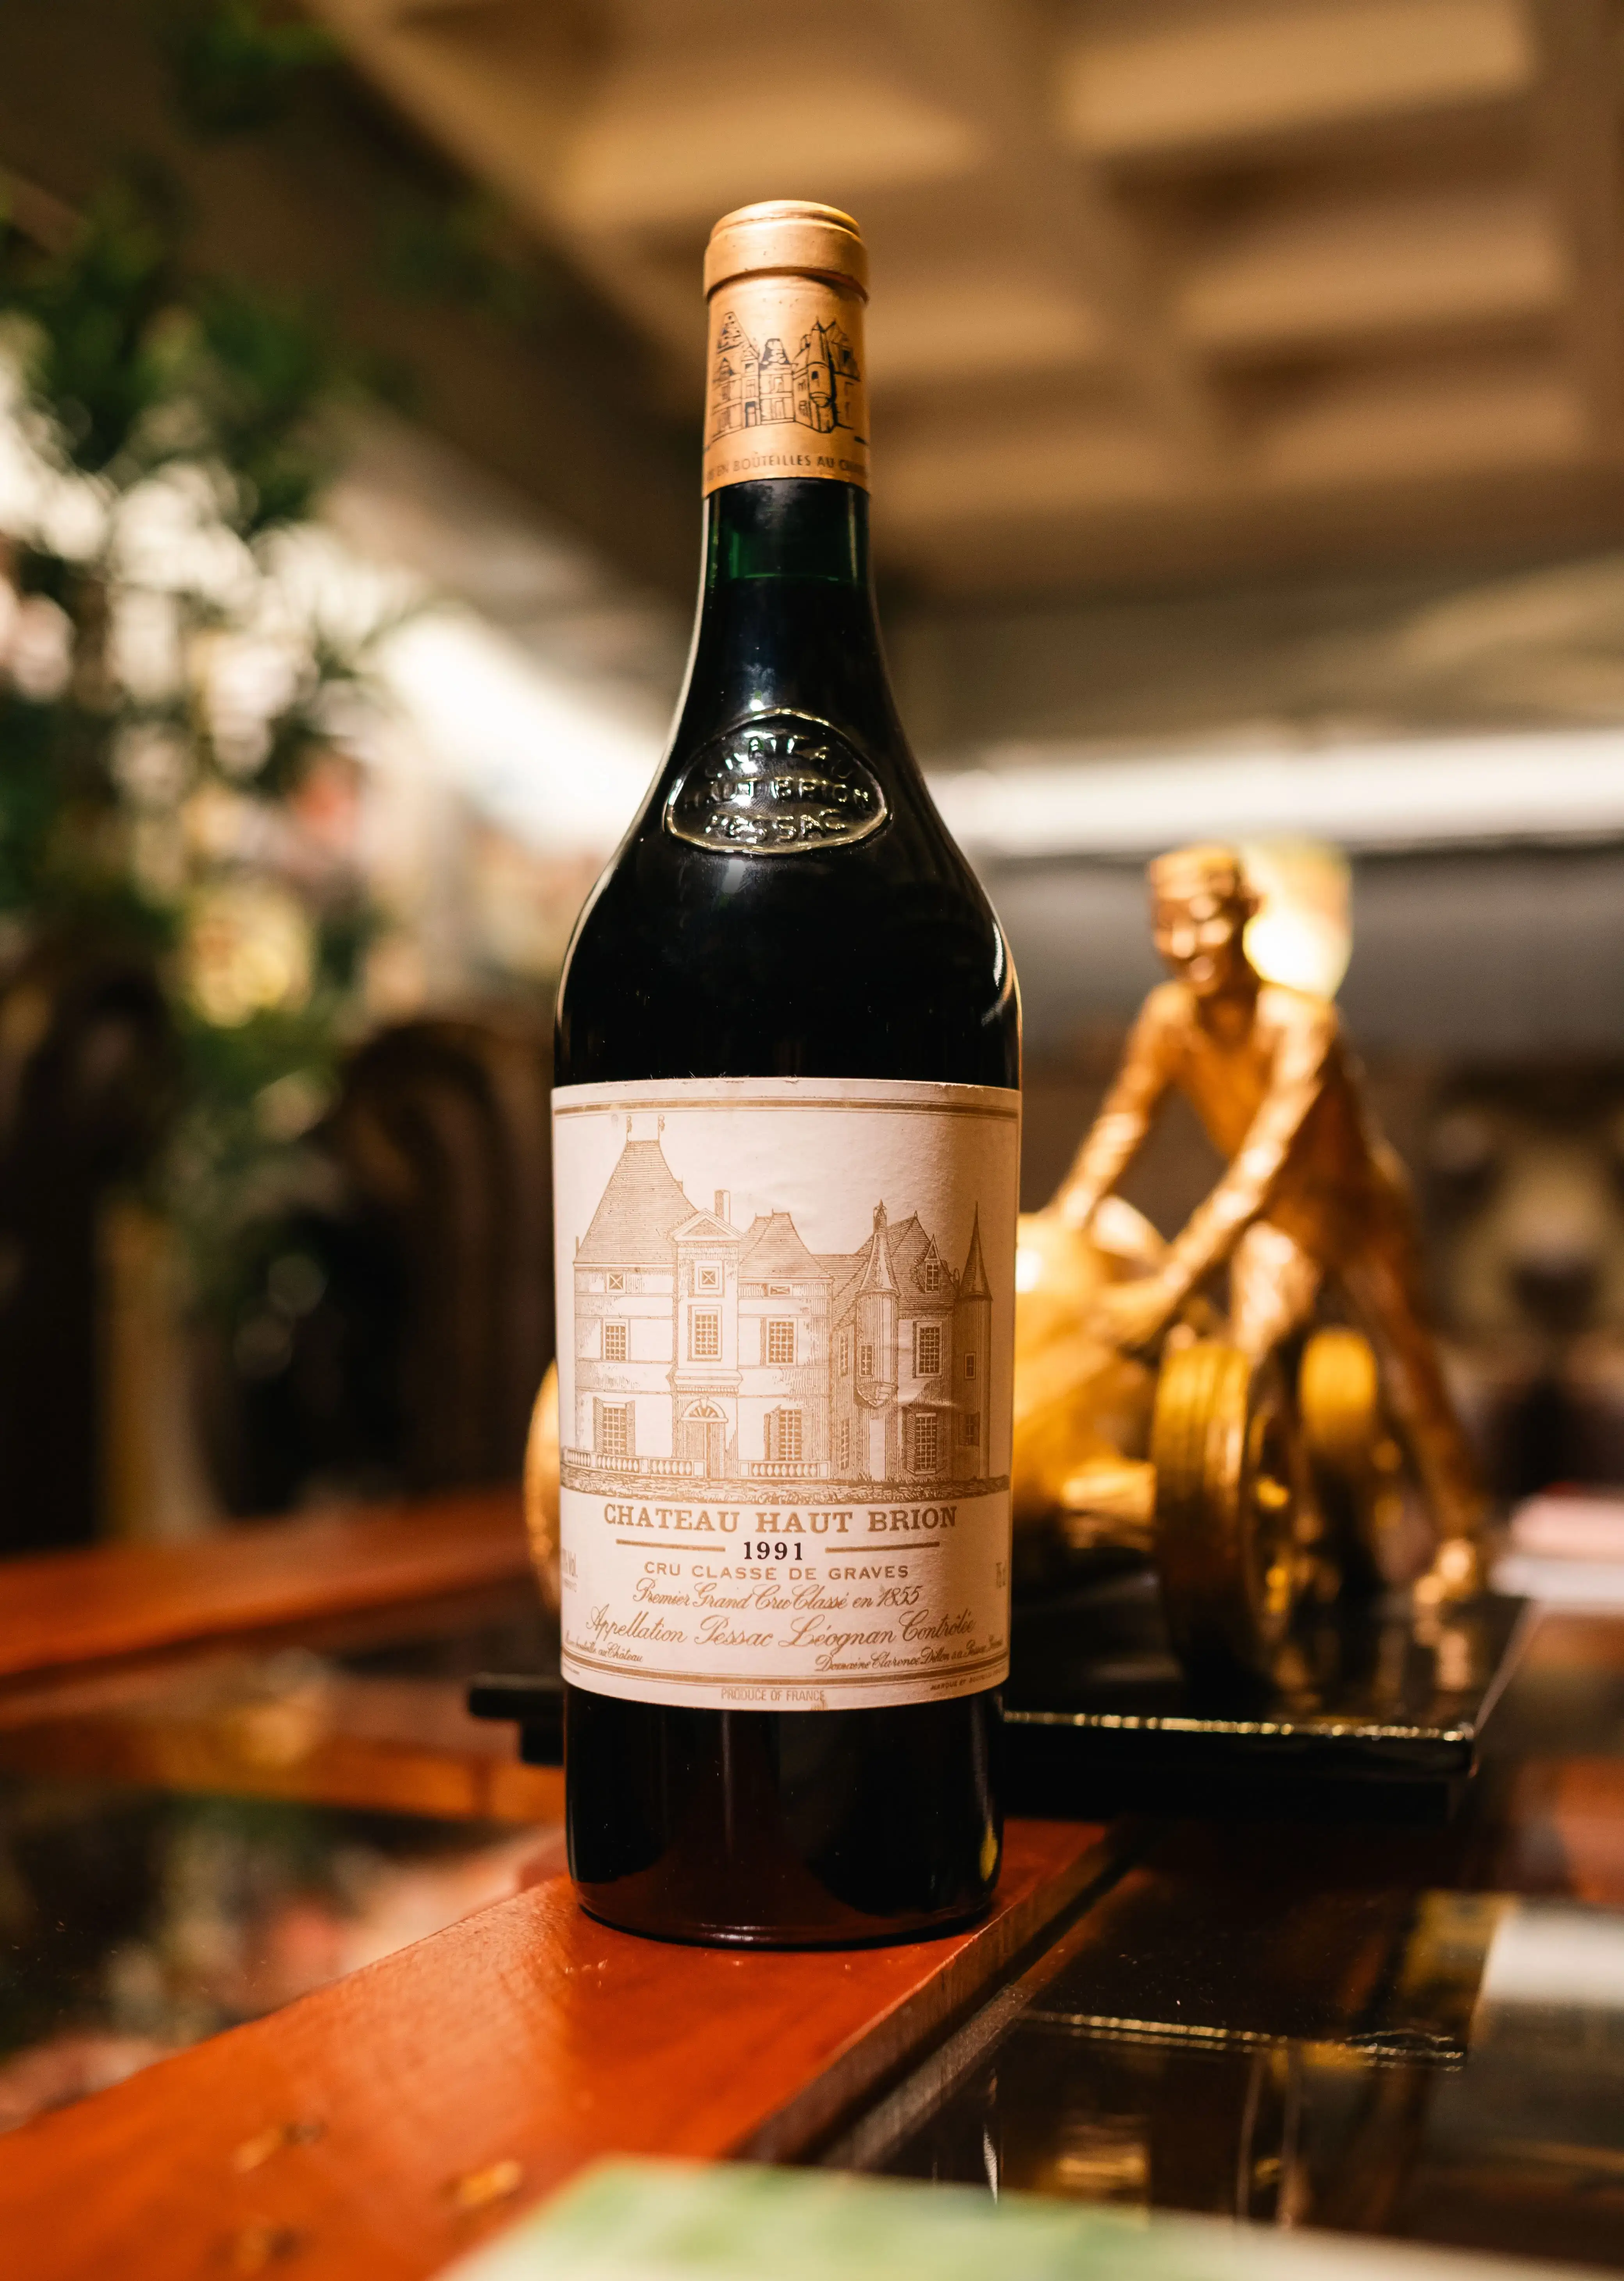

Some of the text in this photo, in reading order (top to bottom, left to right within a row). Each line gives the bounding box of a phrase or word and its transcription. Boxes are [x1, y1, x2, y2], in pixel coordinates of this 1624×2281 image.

[817, 456, 834, 468] AU
[604, 1503, 957, 1533] CHATEAU HAUT BRION
[744, 1541, 803, 1560] 1991
[644, 1561, 681, 1576] CRU
[789, 1567, 817, 1581] DE
[828, 1565, 909, 1580] GRAVES
[633, 1577, 923, 1610] Premier Grand Cru Classé en 1855
[586, 1603, 687, 1643] Appellation
[694, 1614, 774, 1647] Pessac
[778, 1614, 897, 1657] Léognan
[770, 1689, 782, 1702] OF
[786, 1689, 825, 1702] FRANCE
